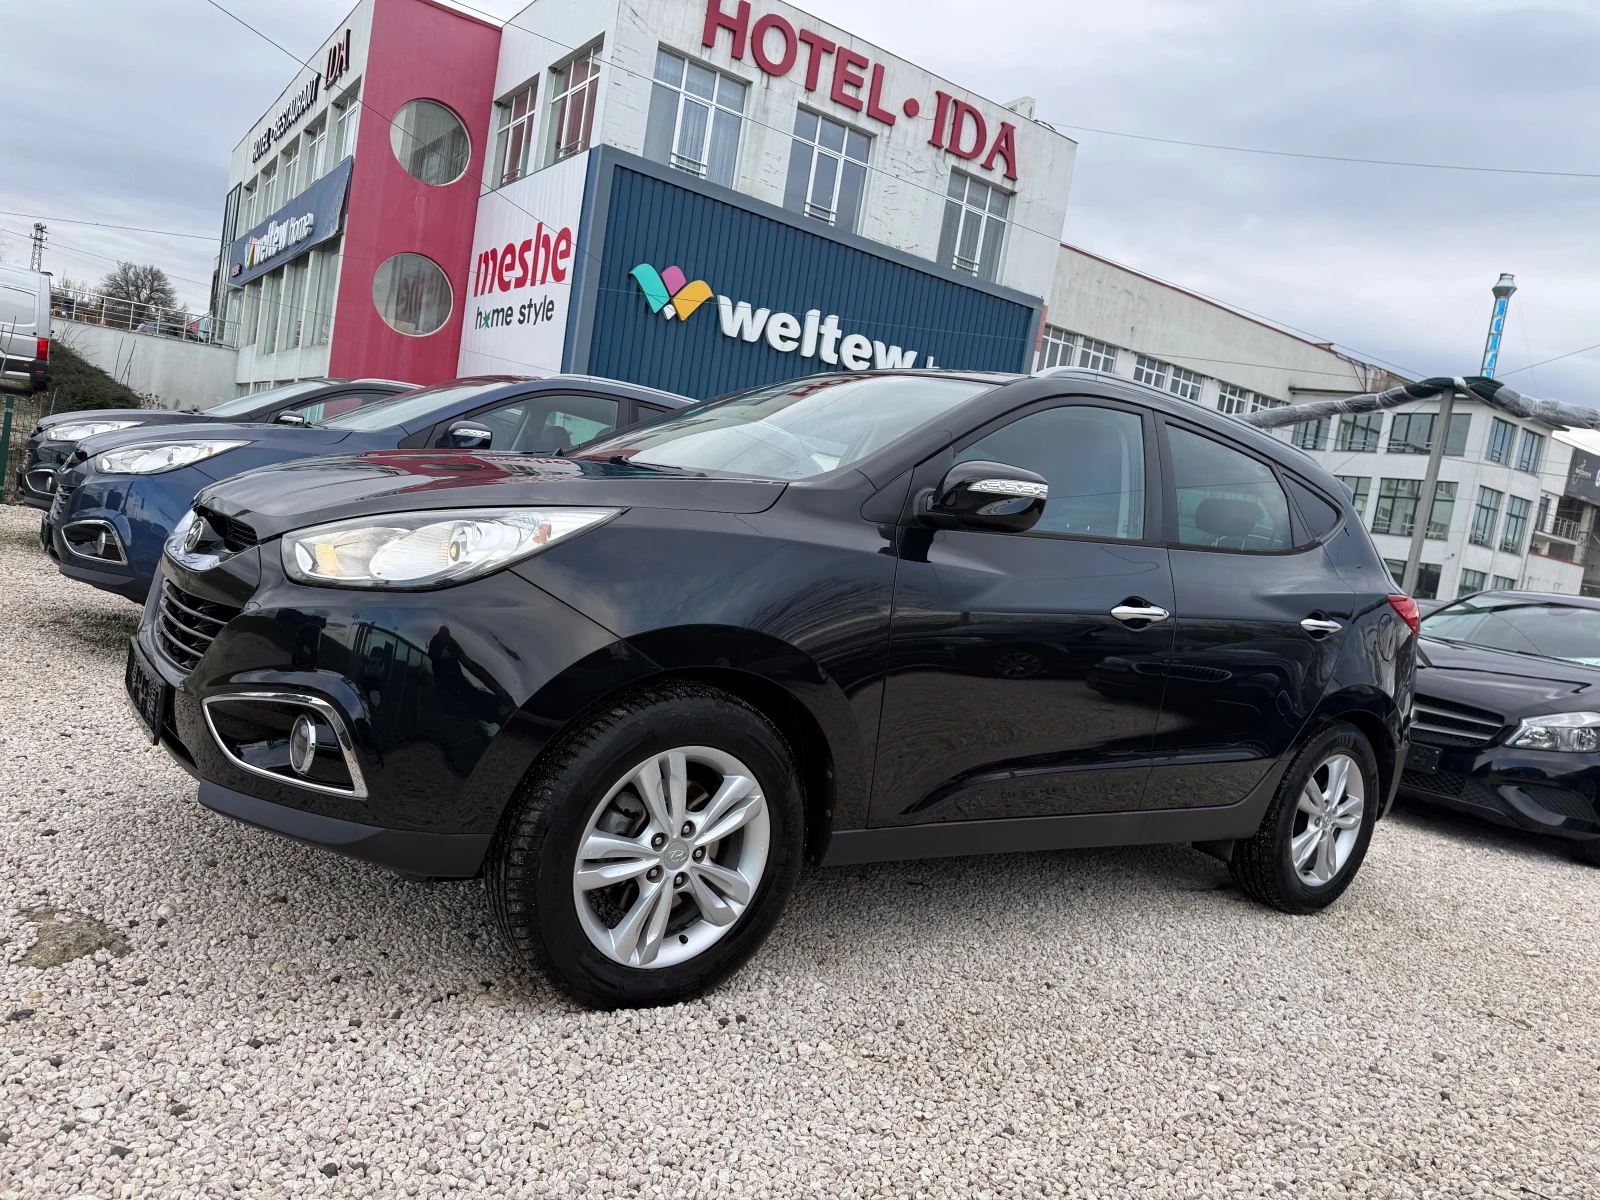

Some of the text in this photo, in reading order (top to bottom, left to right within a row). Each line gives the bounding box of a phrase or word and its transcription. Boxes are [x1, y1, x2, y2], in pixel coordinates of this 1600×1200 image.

[323, 28, 351, 90] IDA
[701, 0, 1018, 181] HOTEL IDA
[473, 222, 572, 298] meshe
[518, 295, 555, 326] style
[717, 294, 918, 371] weltew
